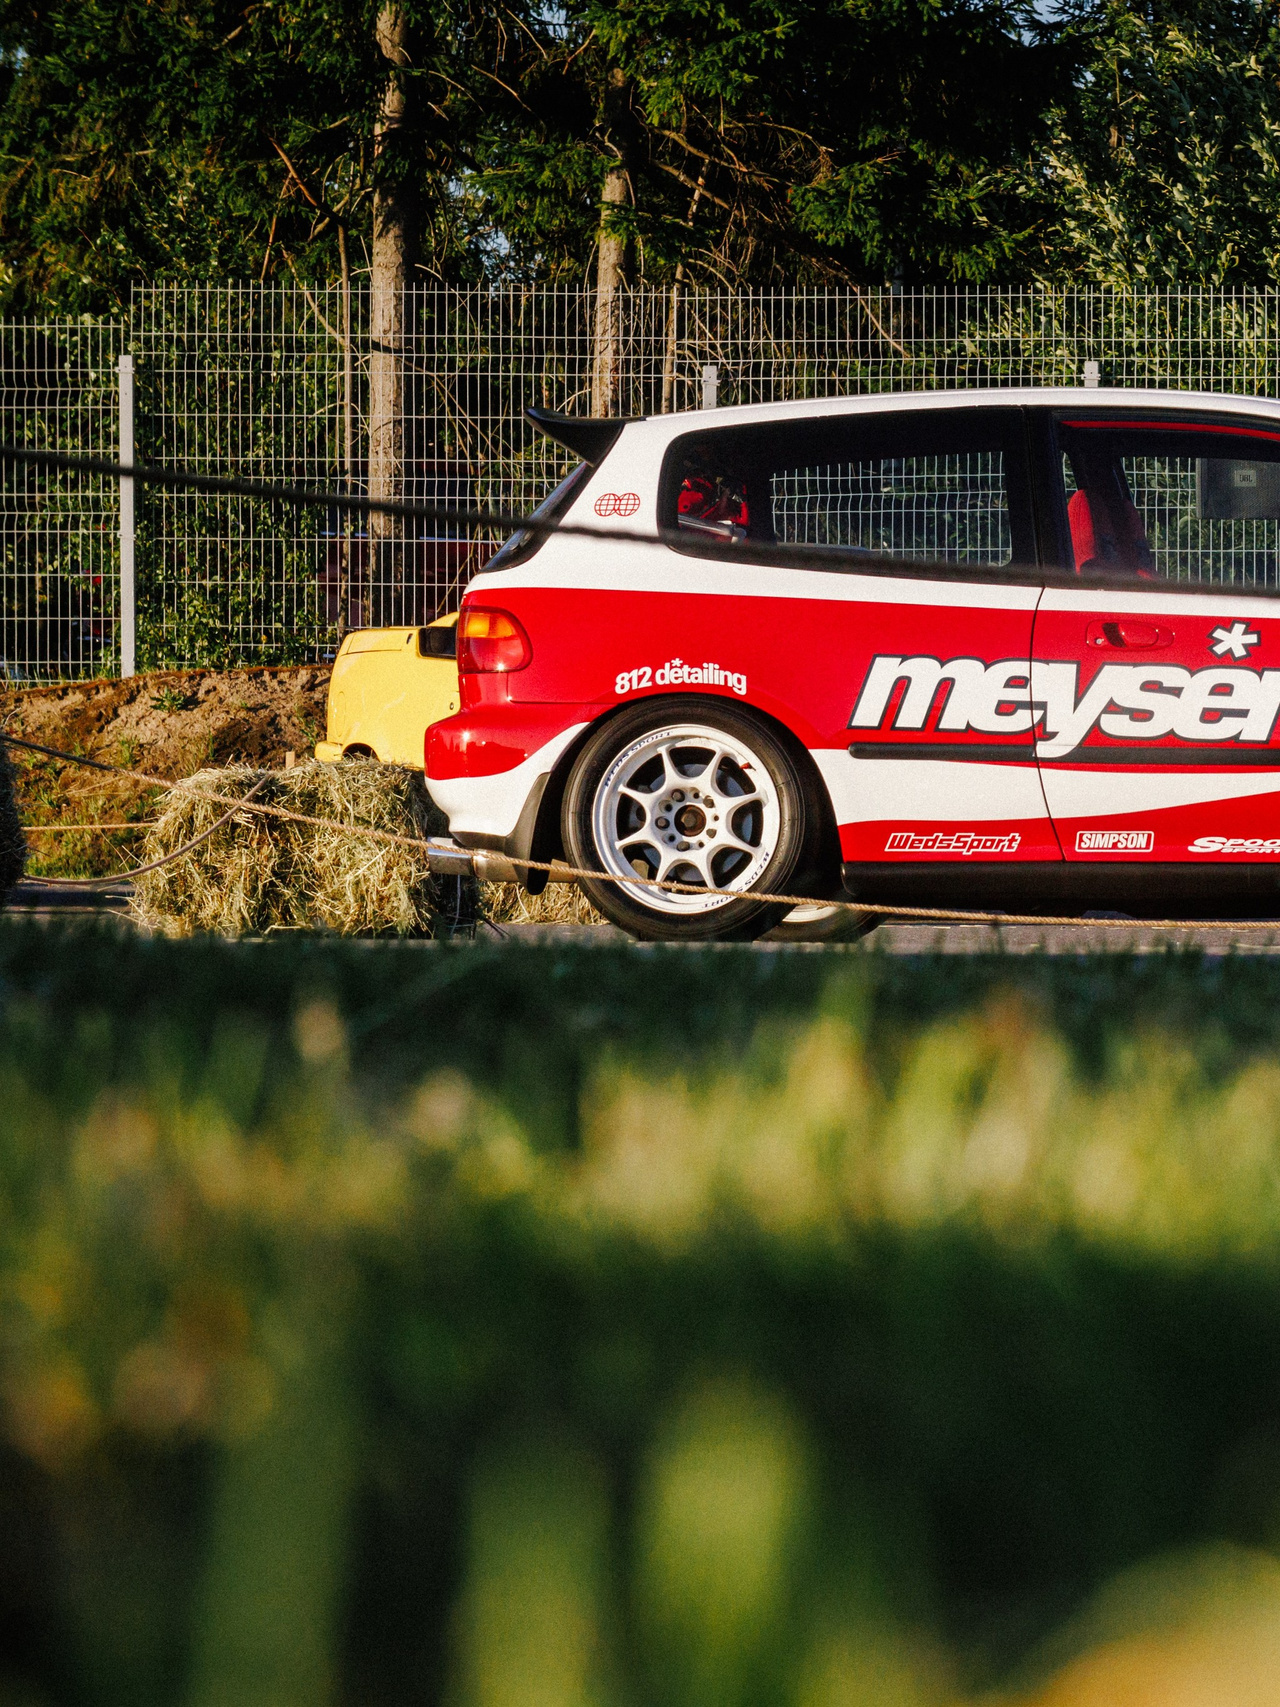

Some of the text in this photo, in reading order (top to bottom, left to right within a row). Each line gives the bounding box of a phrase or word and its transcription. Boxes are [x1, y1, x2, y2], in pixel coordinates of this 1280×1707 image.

[615, 666, 653, 694] 812
[884, 832, 1021, 856] WedsSport
[1080, 833, 1149, 850] SIMPSON
[701, 886, 744, 908] SORT
